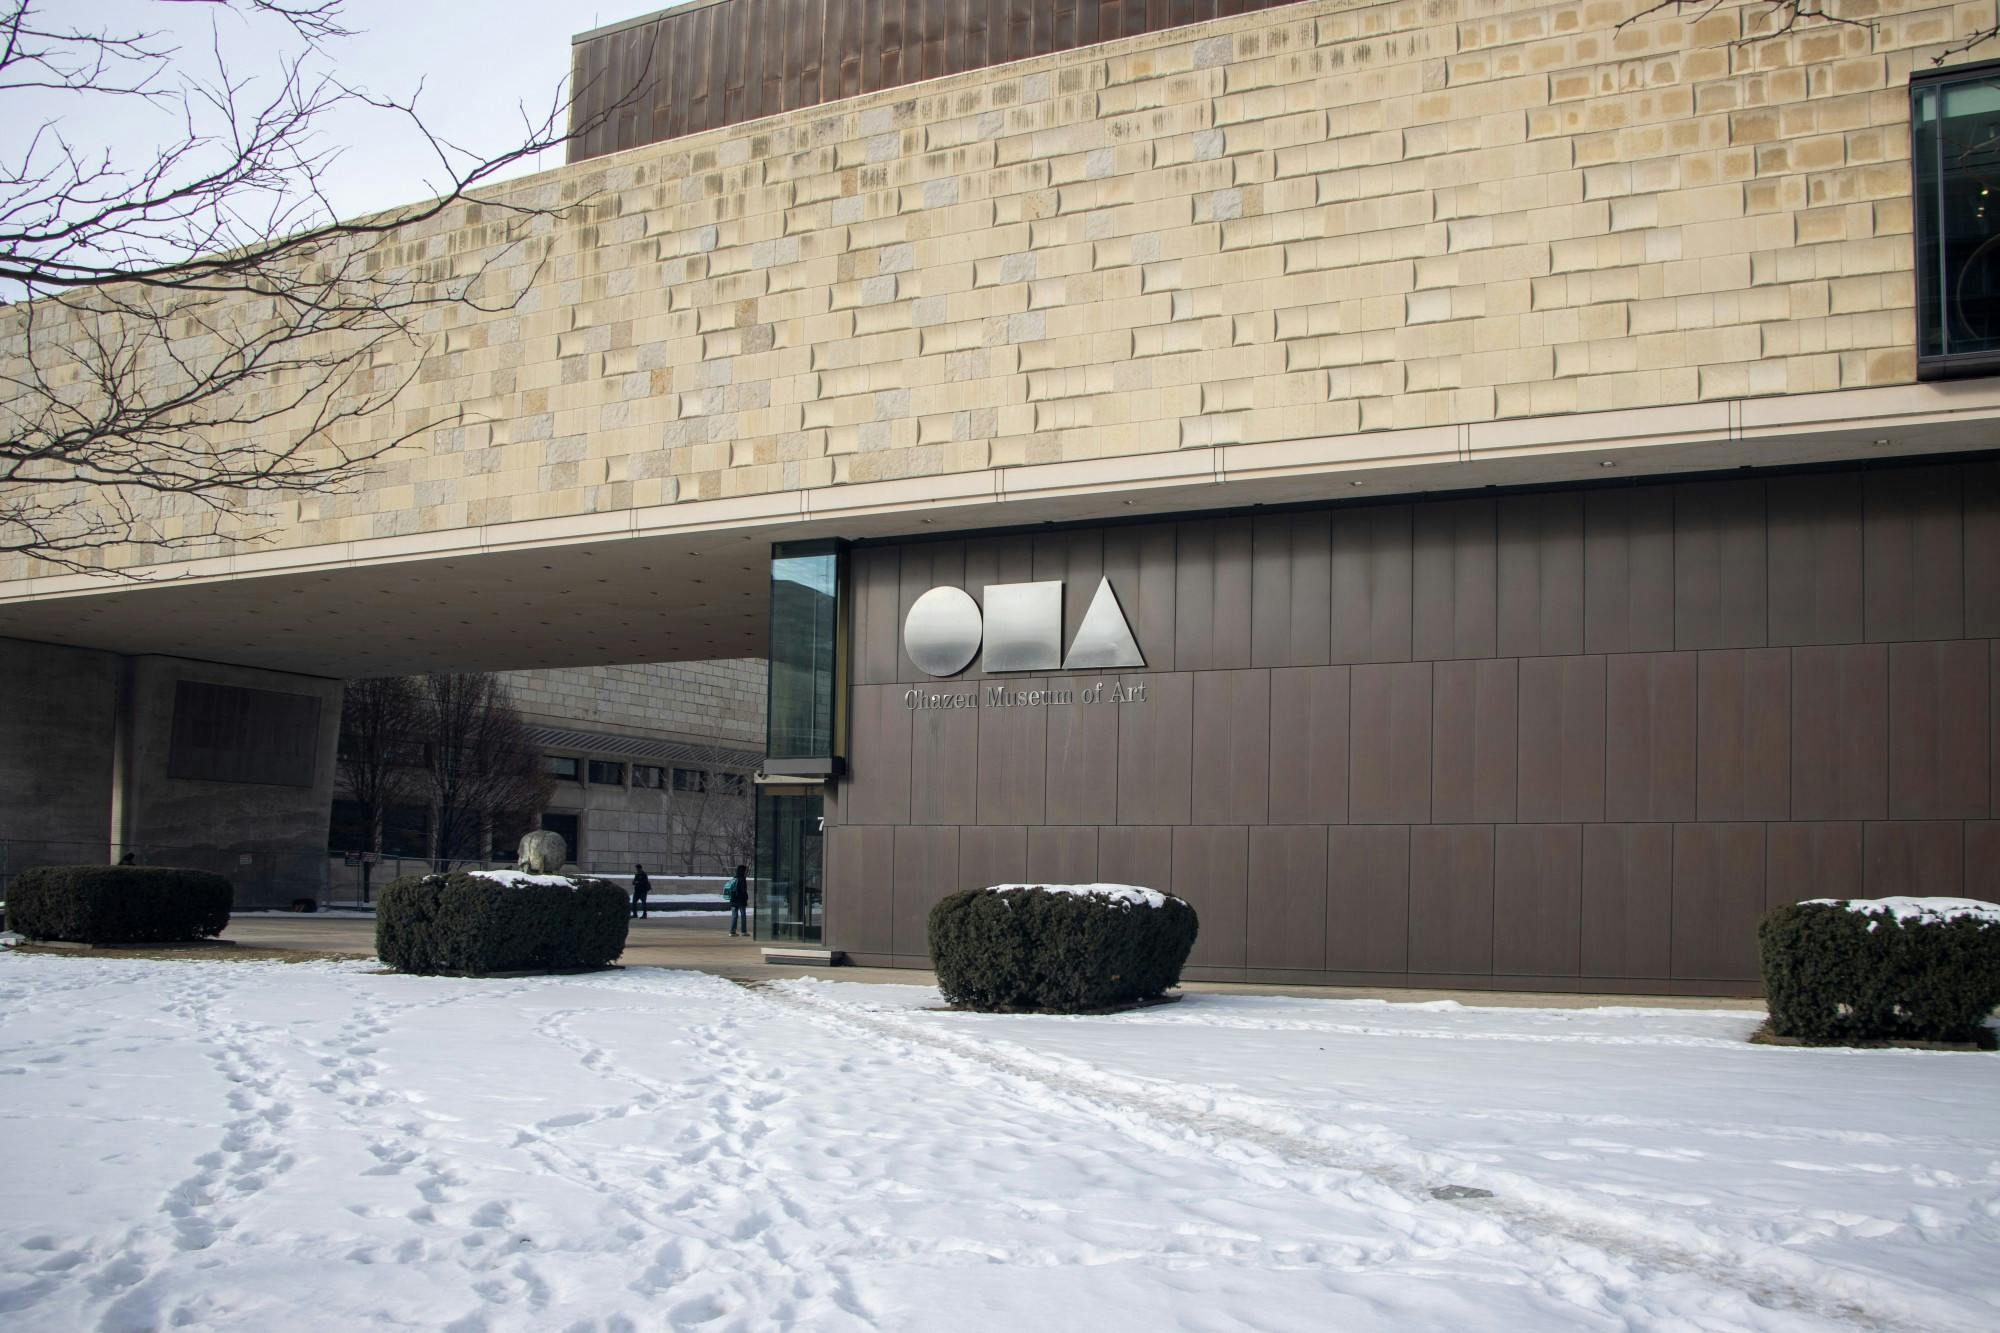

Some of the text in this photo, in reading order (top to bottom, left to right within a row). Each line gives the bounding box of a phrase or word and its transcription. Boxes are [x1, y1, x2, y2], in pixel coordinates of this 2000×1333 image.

[904, 681, 1148, 710] Chazen Museum of Art
